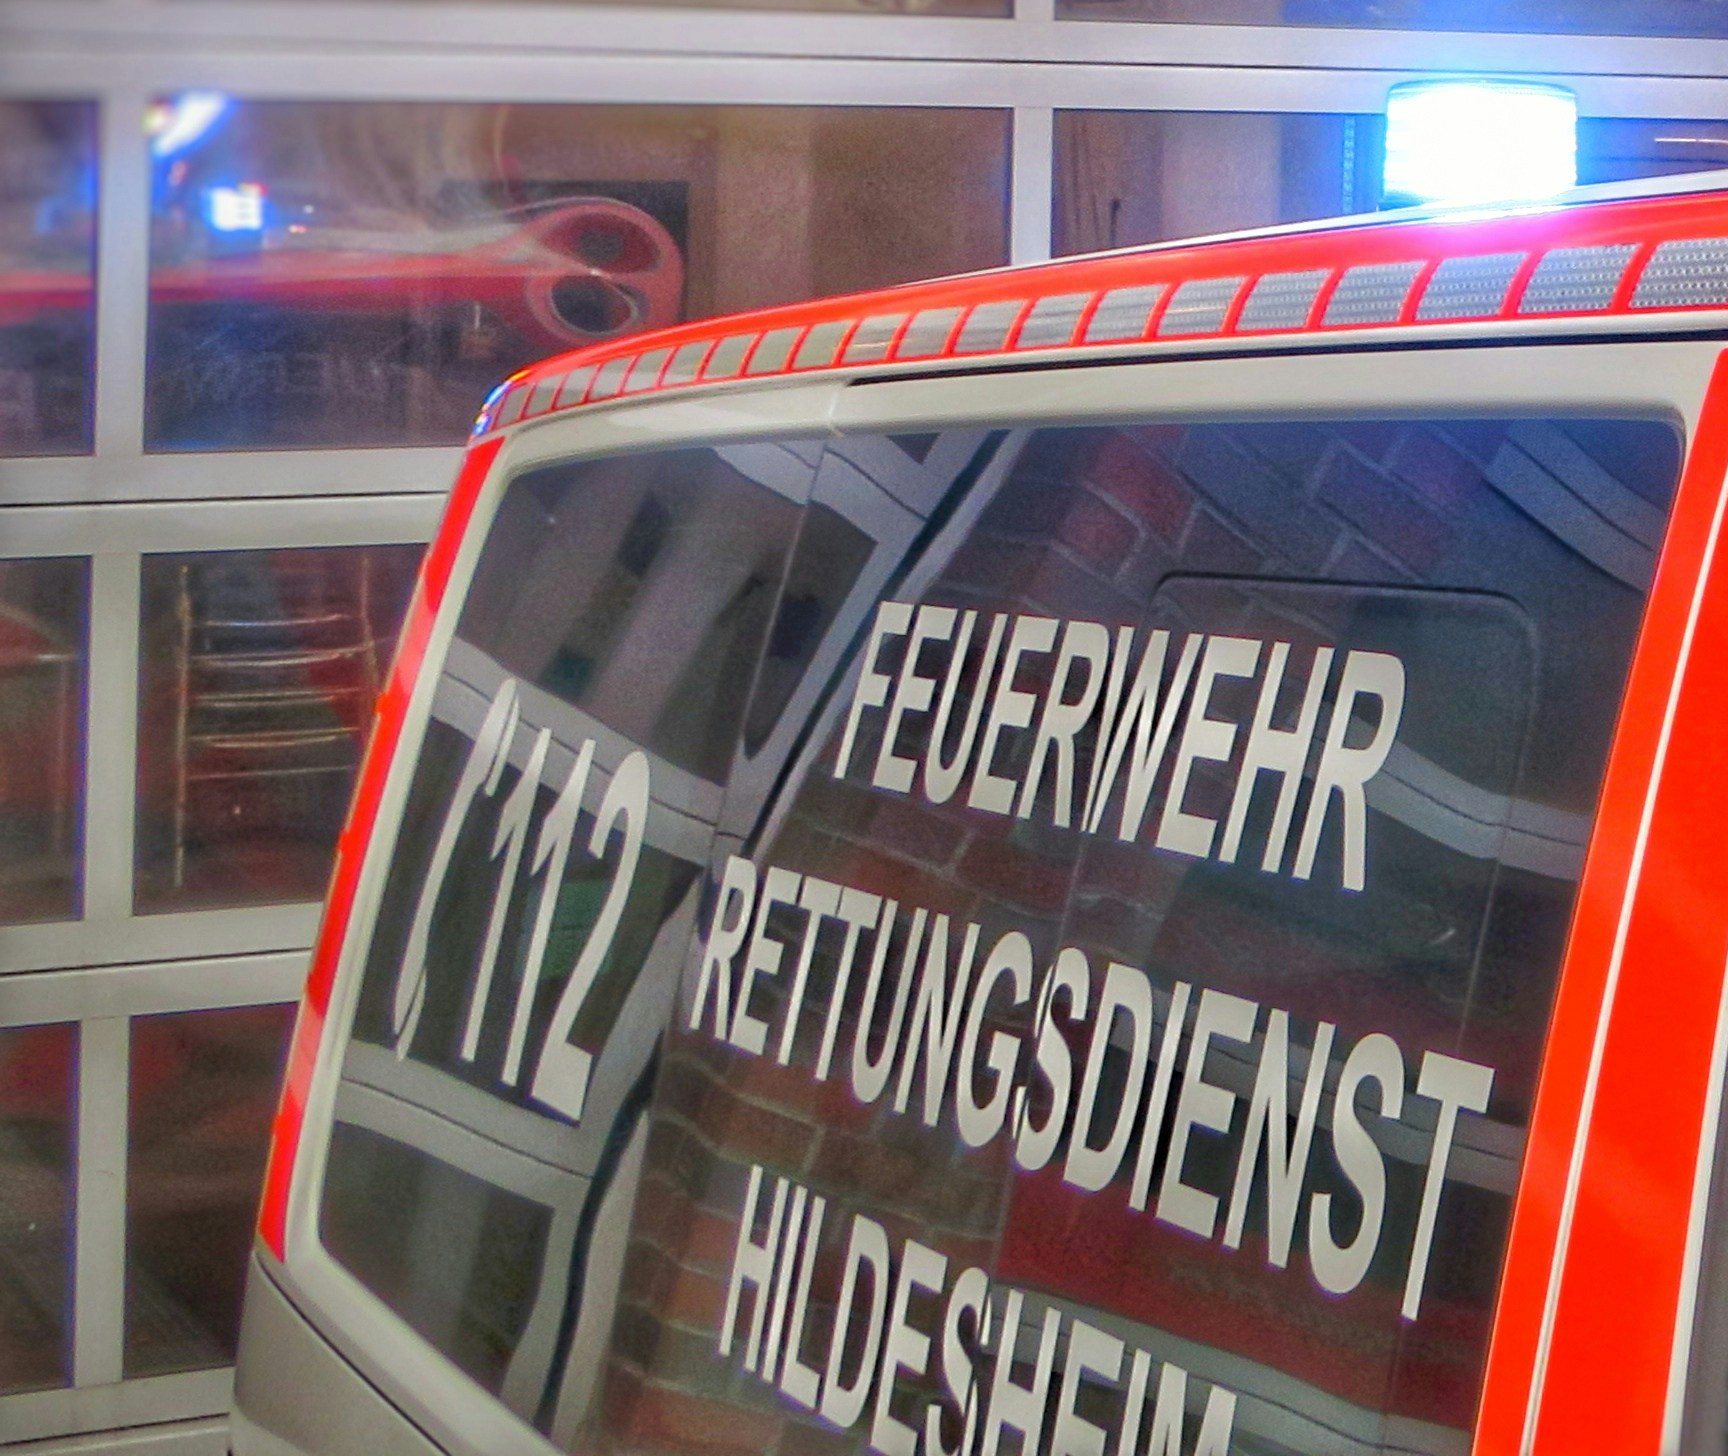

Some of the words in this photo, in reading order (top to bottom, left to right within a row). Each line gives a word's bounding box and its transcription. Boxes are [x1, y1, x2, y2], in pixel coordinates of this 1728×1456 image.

[460, 727, 651, 1128] 112
[833, 600, 1405, 892] FEUERWEHR
[688, 854, 1496, 1322] RETTUNGSDIENST
